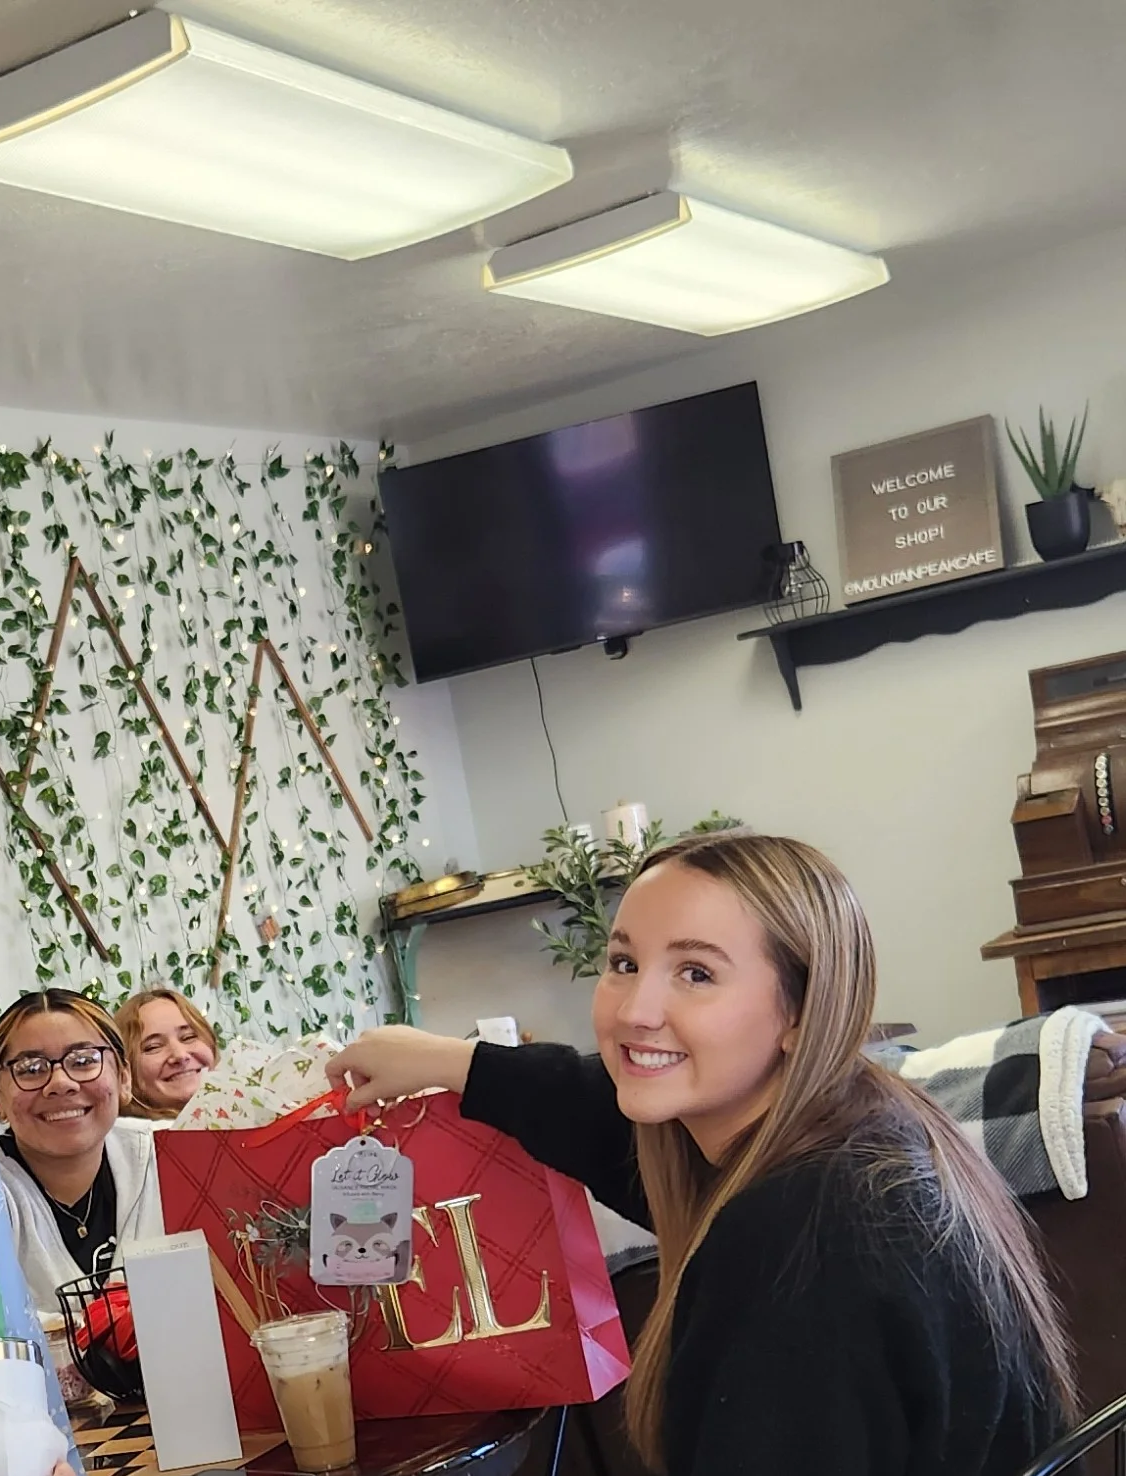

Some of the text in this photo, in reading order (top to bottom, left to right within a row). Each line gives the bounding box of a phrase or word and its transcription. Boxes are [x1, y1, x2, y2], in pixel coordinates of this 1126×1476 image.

[872, 464, 955, 495] WELCOME
[888, 495, 948, 521] TO OUR
[895, 524, 945, 549] SHOP!
